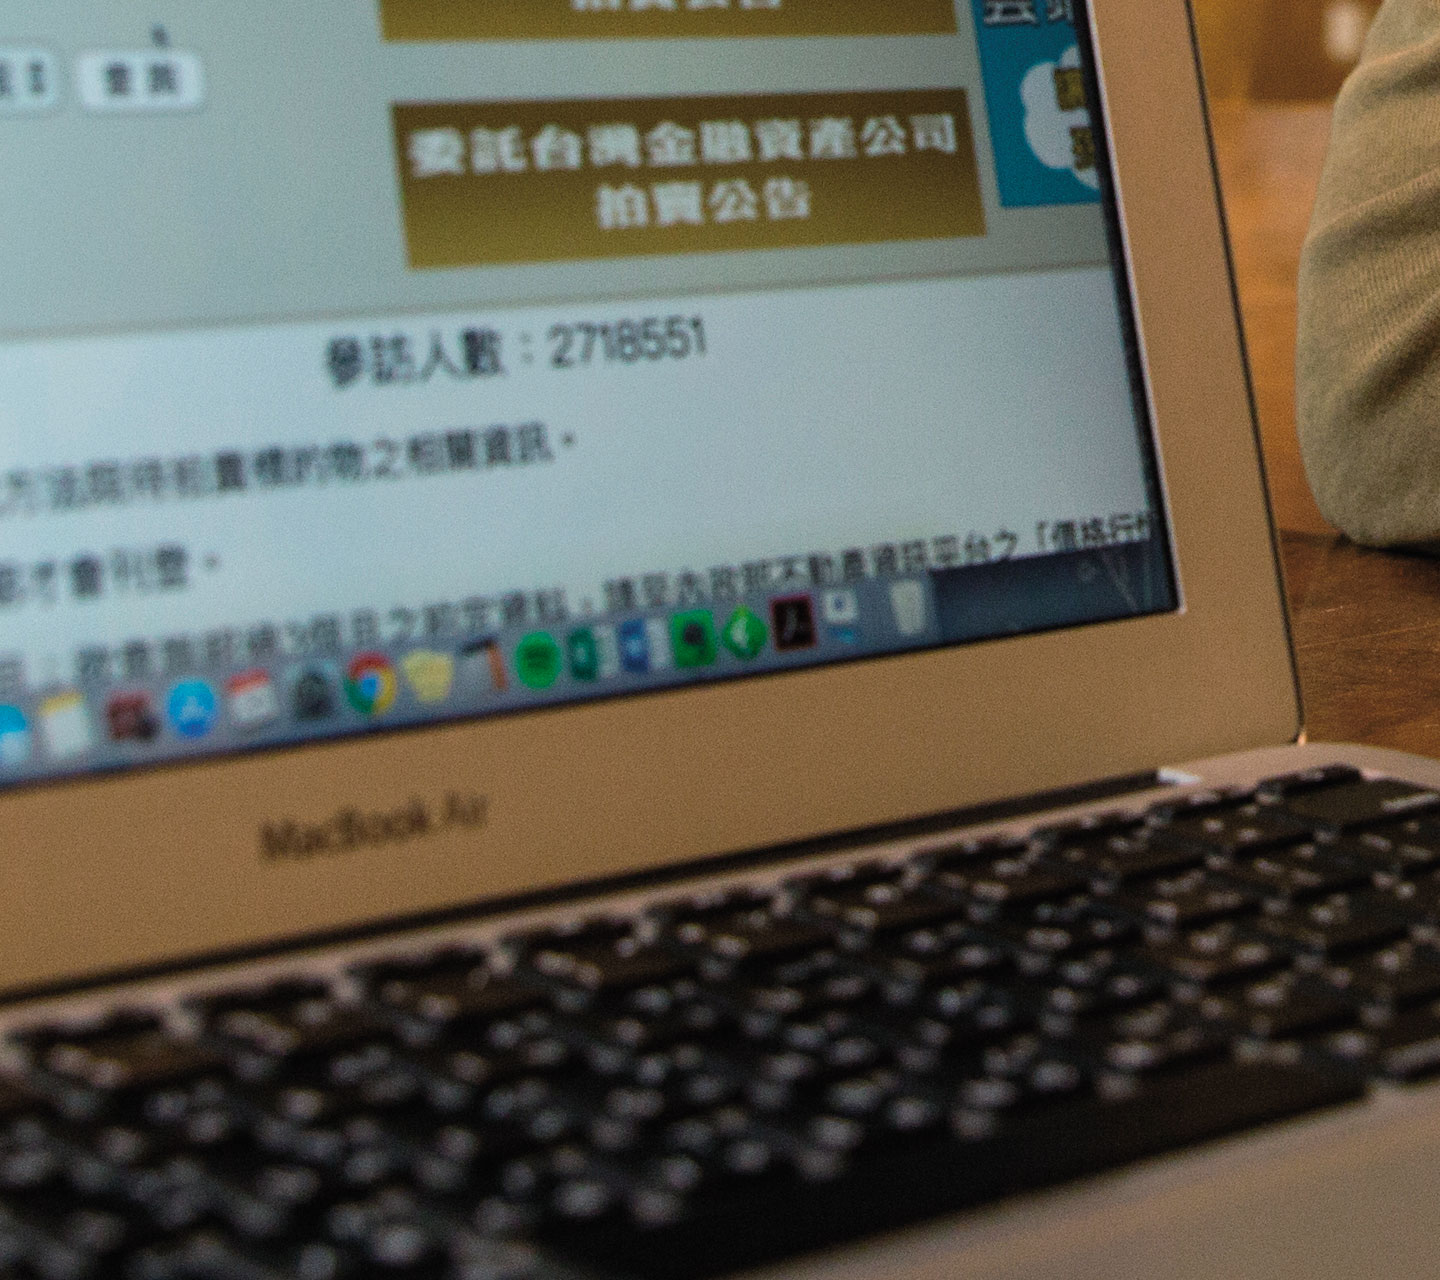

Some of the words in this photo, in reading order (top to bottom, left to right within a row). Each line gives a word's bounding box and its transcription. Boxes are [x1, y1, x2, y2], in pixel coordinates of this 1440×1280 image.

[408, 113, 959, 179] 委託台灣金融資產公司
[596, 177, 813, 230] 拍賣公告
[259, 802, 431, 863] MacBook
